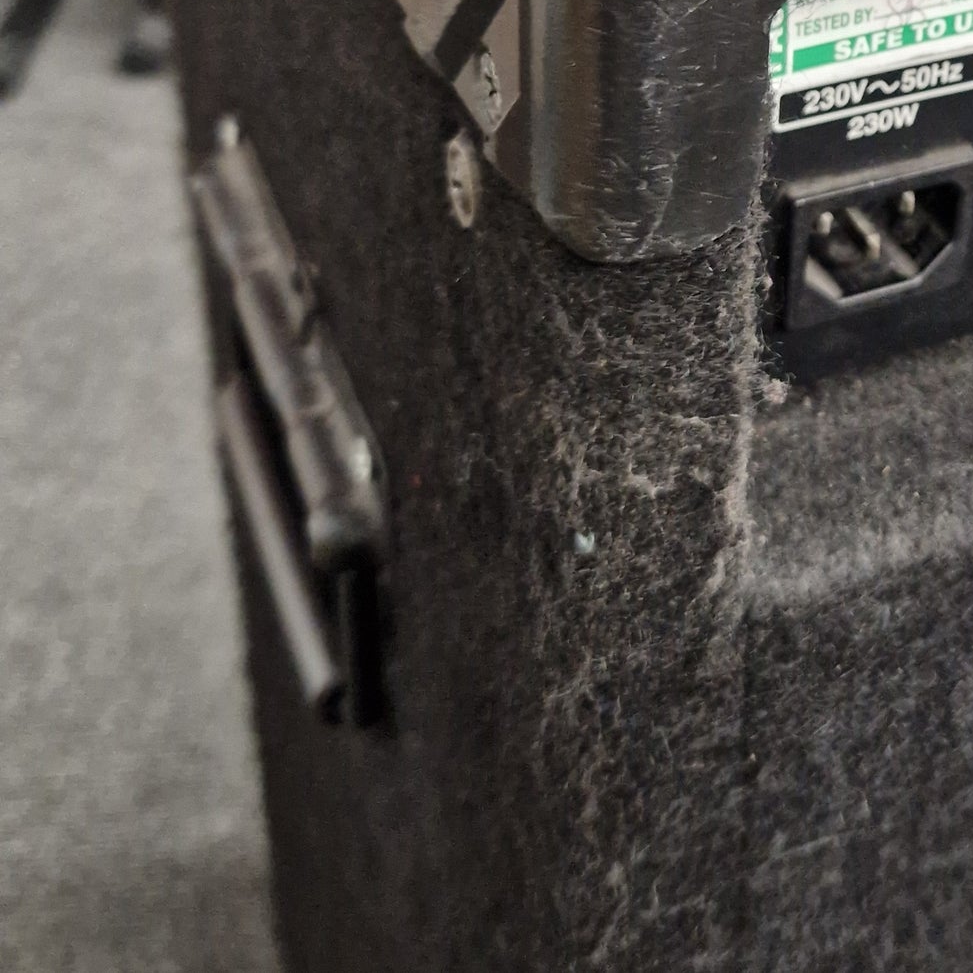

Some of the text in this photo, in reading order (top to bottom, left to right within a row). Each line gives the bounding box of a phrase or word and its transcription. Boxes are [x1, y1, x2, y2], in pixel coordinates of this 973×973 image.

[794, 10, 852, 38] TESTED
[853, 7, 873, 27] BY
[834, 24, 904, 61] SAFE
[913, 17, 947, 44] TO
[846, 102, 920, 140] 230W
